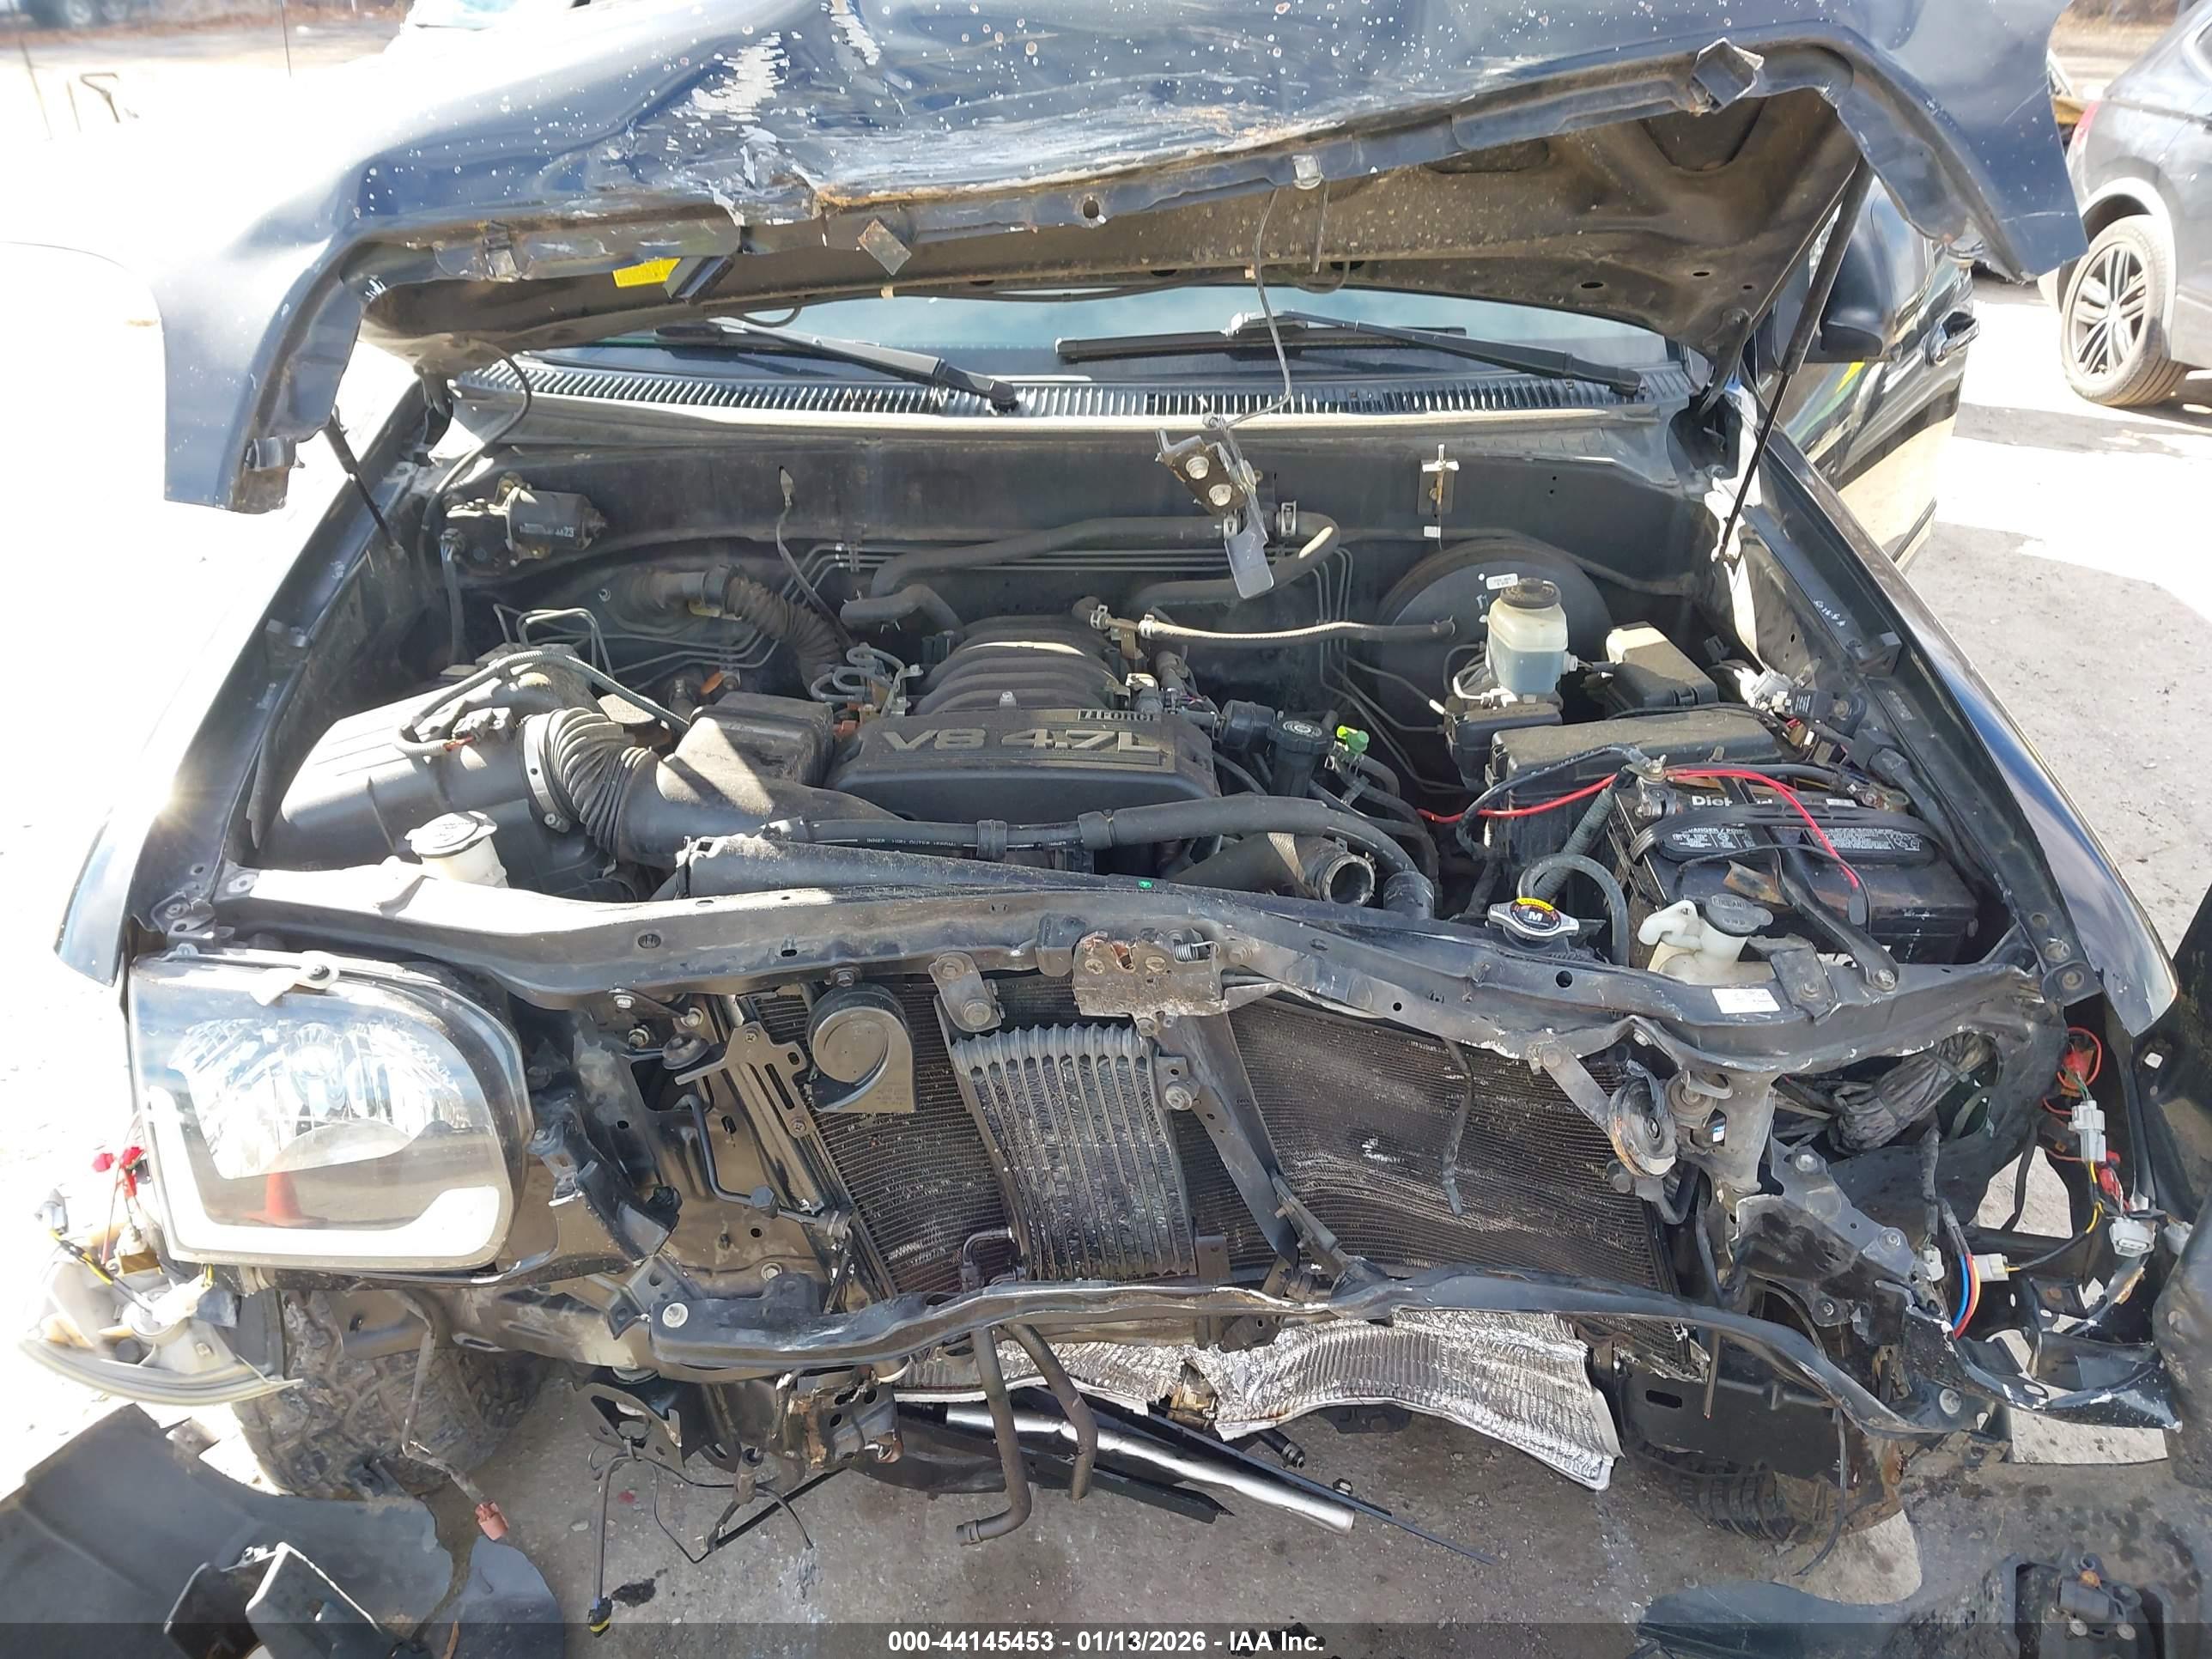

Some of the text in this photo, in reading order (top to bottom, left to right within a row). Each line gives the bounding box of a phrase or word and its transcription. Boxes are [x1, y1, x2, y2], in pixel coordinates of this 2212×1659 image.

[882, 729, 1160, 753] V8 4.7L
[1528, 911, 1543, 922] M
